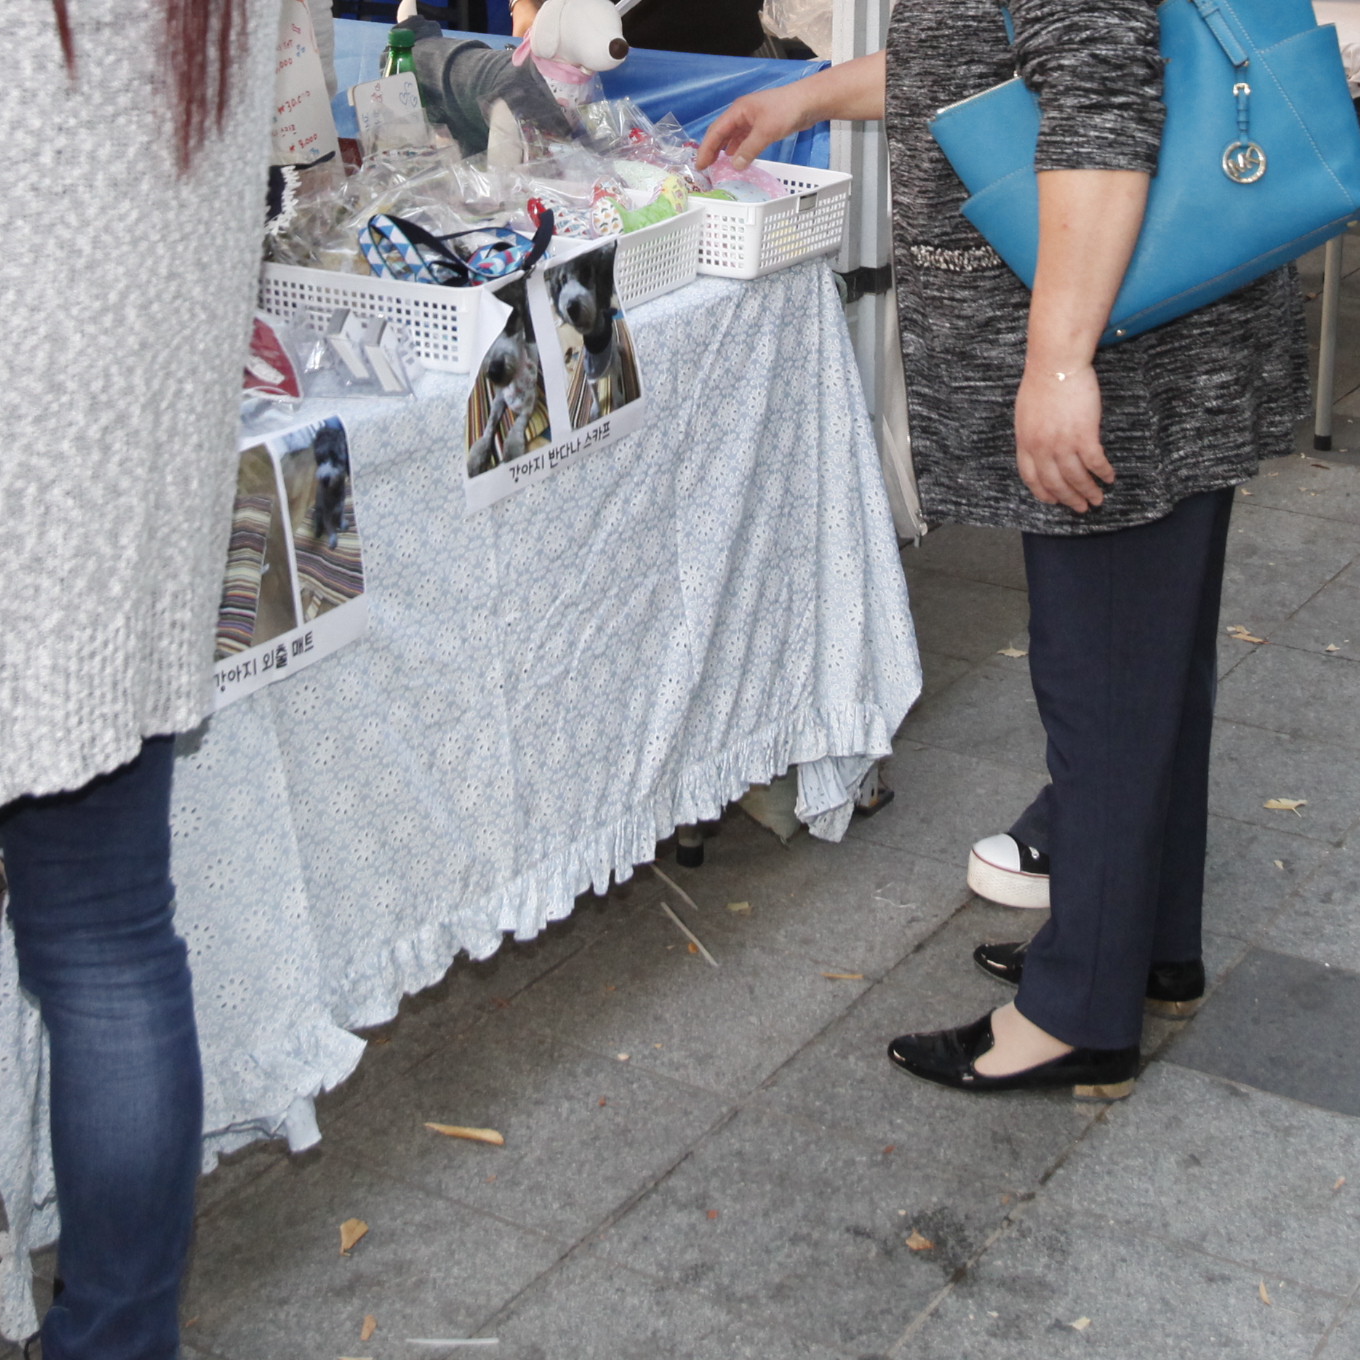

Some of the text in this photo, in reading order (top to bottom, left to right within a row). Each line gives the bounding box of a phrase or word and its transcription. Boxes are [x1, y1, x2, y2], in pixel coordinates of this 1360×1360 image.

[509, 420, 611, 483] 강아지 반다나 스카프
[213, 630, 314, 692] 강아지 외출 매트
